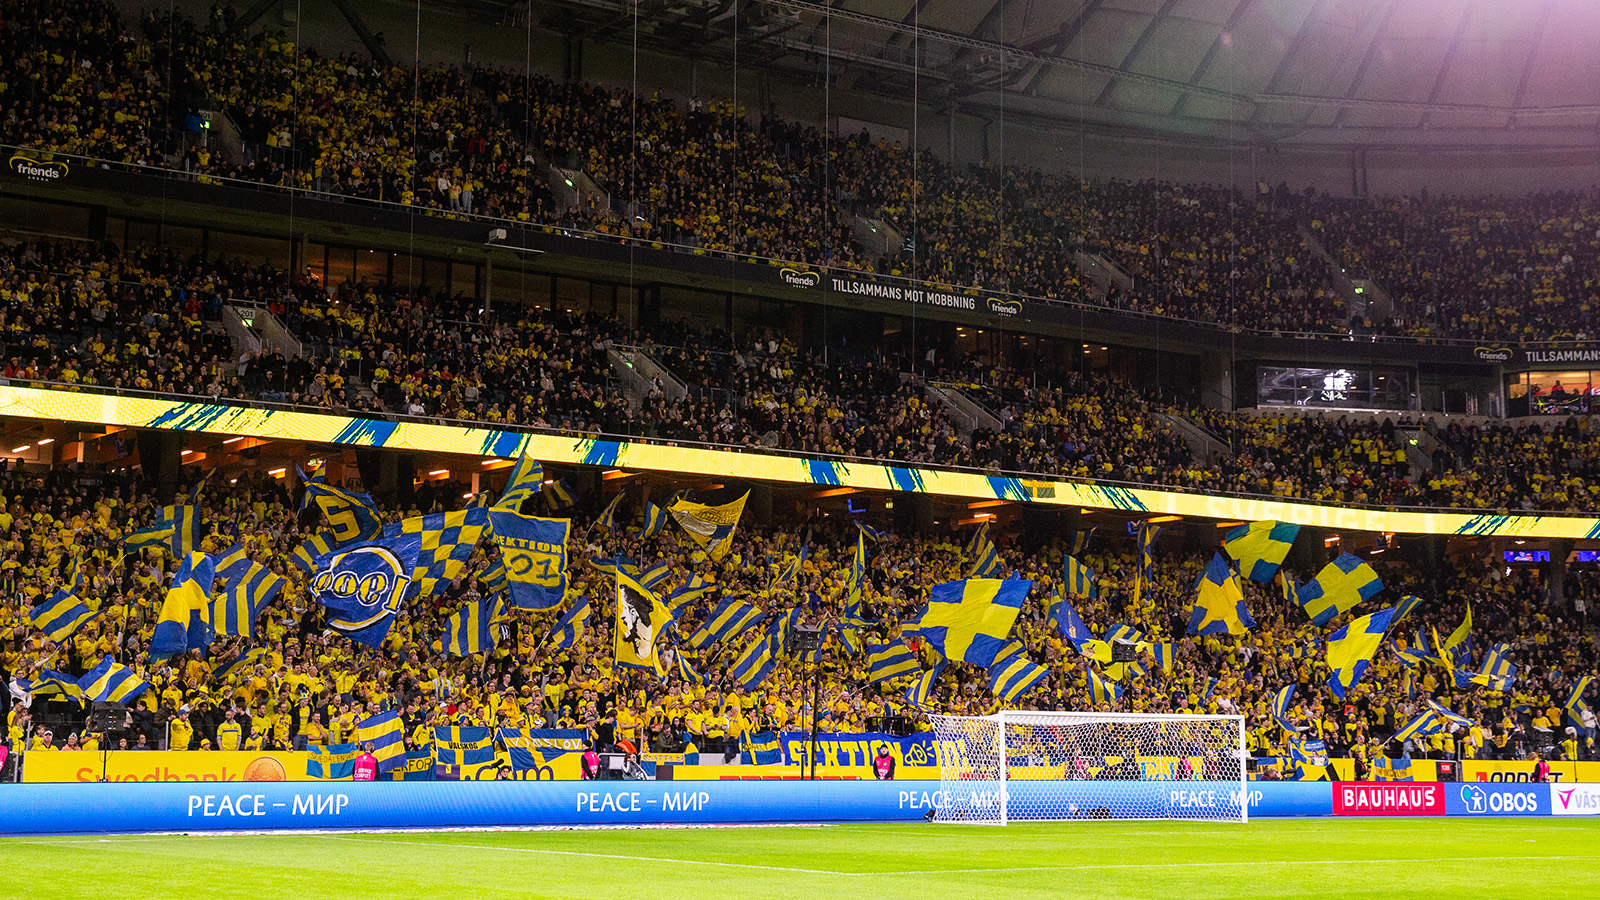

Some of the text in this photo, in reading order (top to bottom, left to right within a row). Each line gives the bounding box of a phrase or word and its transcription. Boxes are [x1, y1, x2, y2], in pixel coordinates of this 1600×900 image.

[17, 162, 60, 179] friends
[785, 272, 814, 286] friends
[832, 279, 976, 310] TILLSAMMANS MOT MOBBNING
[992, 302, 1018, 315] friends
[1479, 350, 1508, 361] friends
[1525, 351, 1600, 362] TILLSAMMAN
[448, 741, 479, 750] VALSKOG
[188, 794, 266, 817] PEACE
[292, 793, 349, 816] МИР
[576, 792, 642, 812] PEACE
[662, 791, 710, 812] МИР
[899, 791, 952, 809] PEACE
[1170, 790, 1216, 807] PEACE
[1344, 789, 1436, 808] BAUHAUS
[1489, 792, 1538, 812] OBOS
